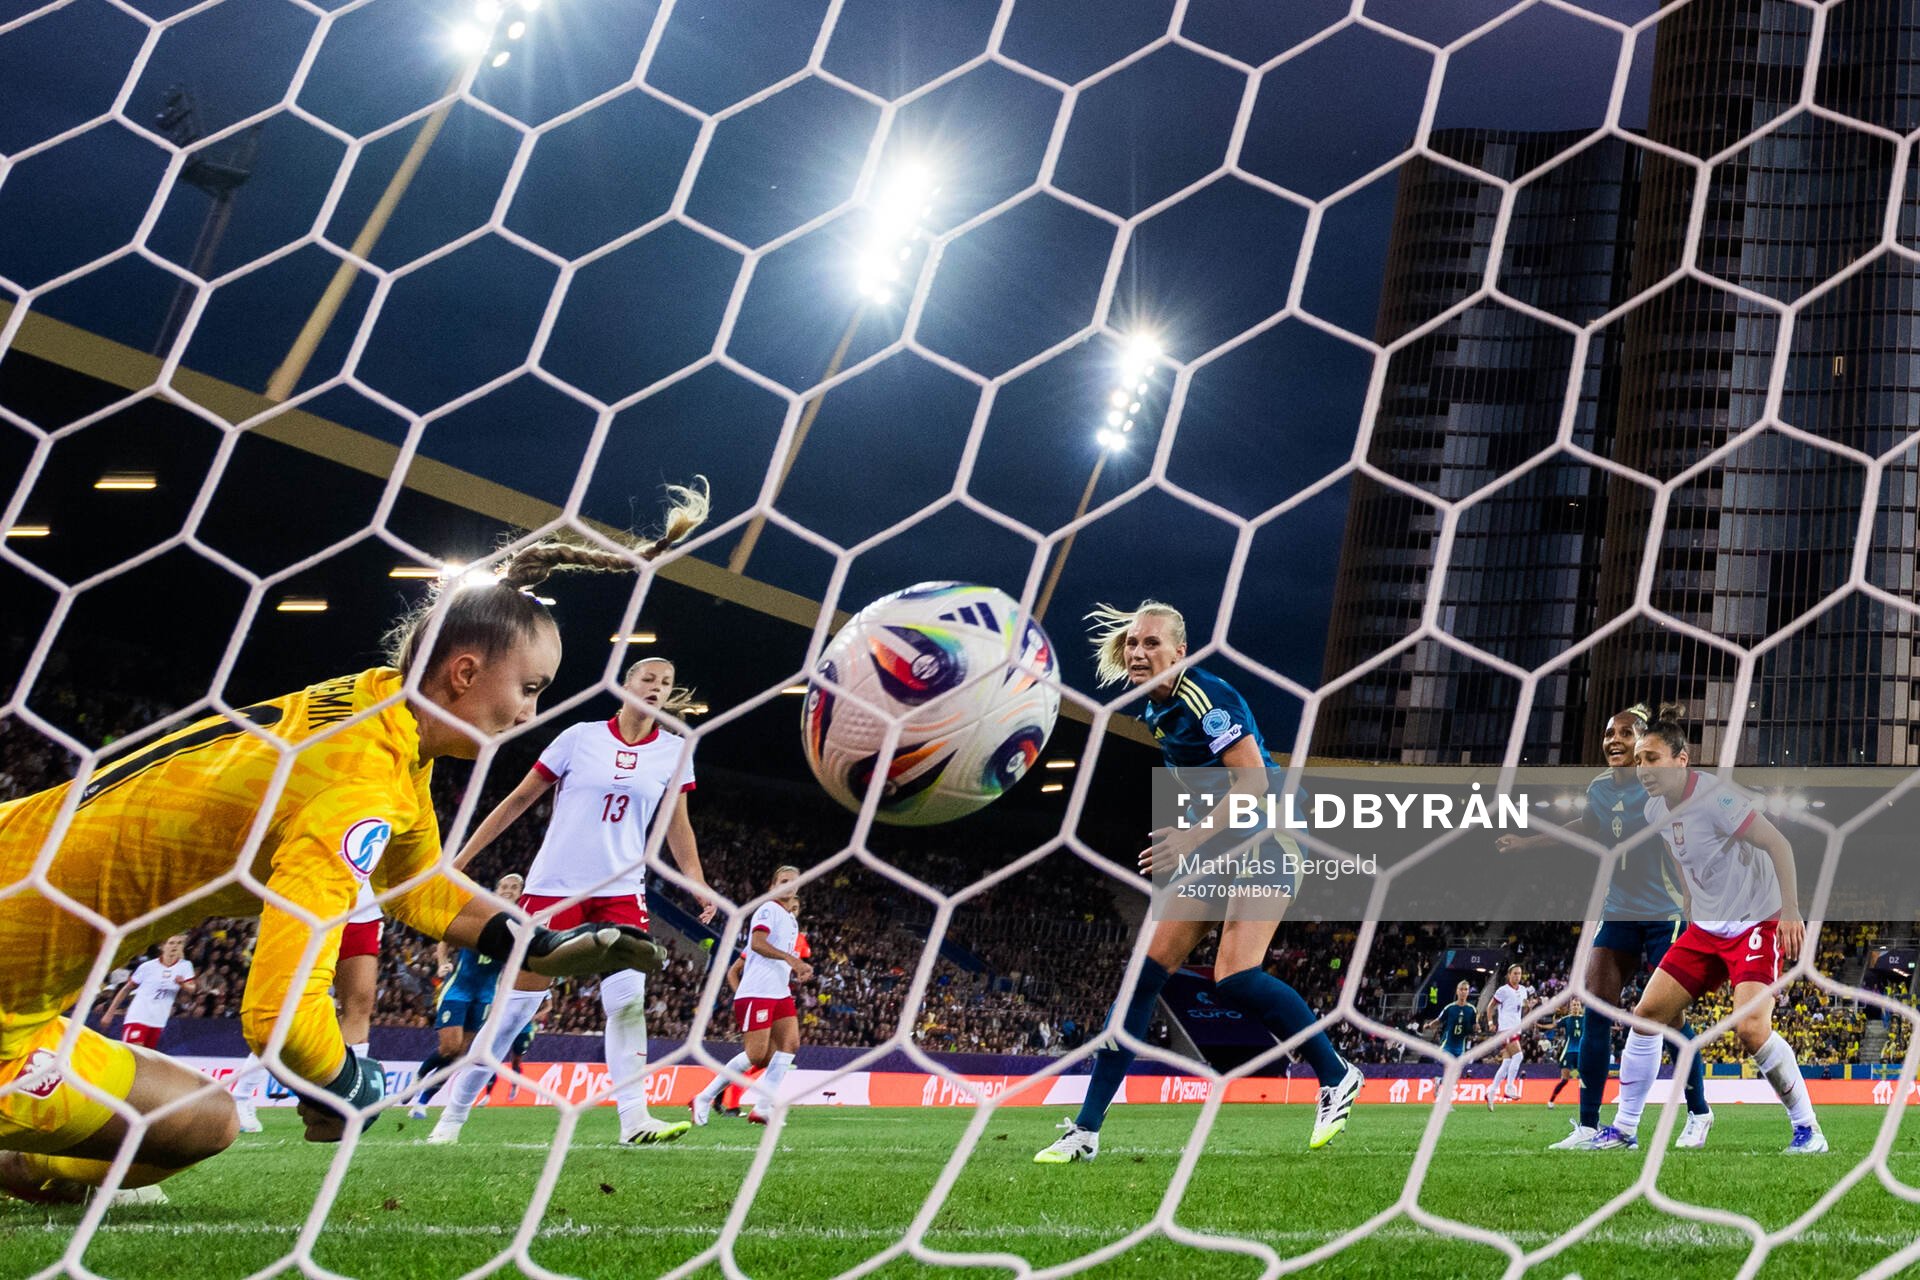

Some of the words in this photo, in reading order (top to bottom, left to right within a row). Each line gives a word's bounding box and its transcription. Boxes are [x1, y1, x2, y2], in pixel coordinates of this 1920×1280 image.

[308, 676, 355, 730] EMIK
[601, 792, 631, 823] 13
[1748, 926, 1762, 950] 6
[1453, 1024, 1464, 1036] 15
[566, 1063, 679, 1104] Pyse.pl
